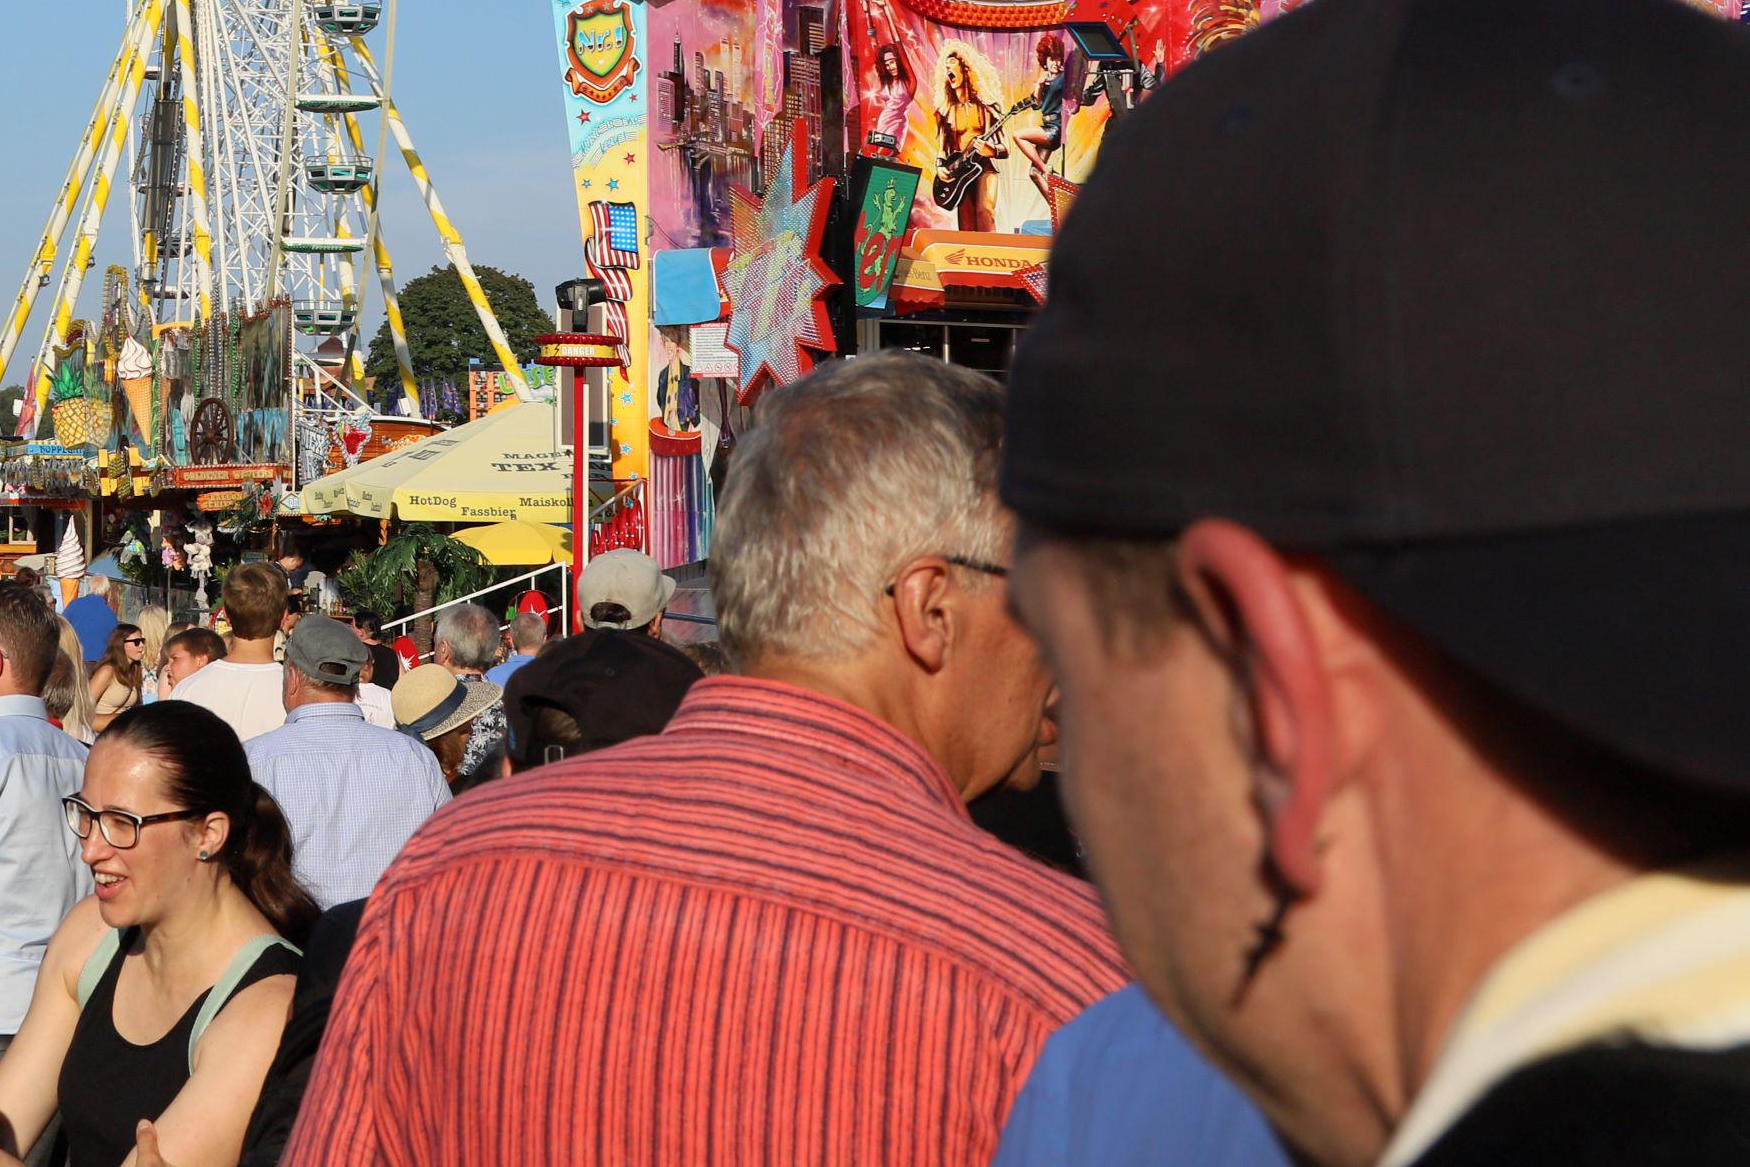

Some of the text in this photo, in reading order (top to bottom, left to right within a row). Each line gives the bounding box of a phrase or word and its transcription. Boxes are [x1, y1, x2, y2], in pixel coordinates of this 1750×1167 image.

[966, 256, 1032, 268] HONDA
[561, 345, 595, 356] DANGER
[491, 462, 560, 472] TEX
[409, 495, 457, 508] HotDog
[461, 506, 516, 517] Fassbier
